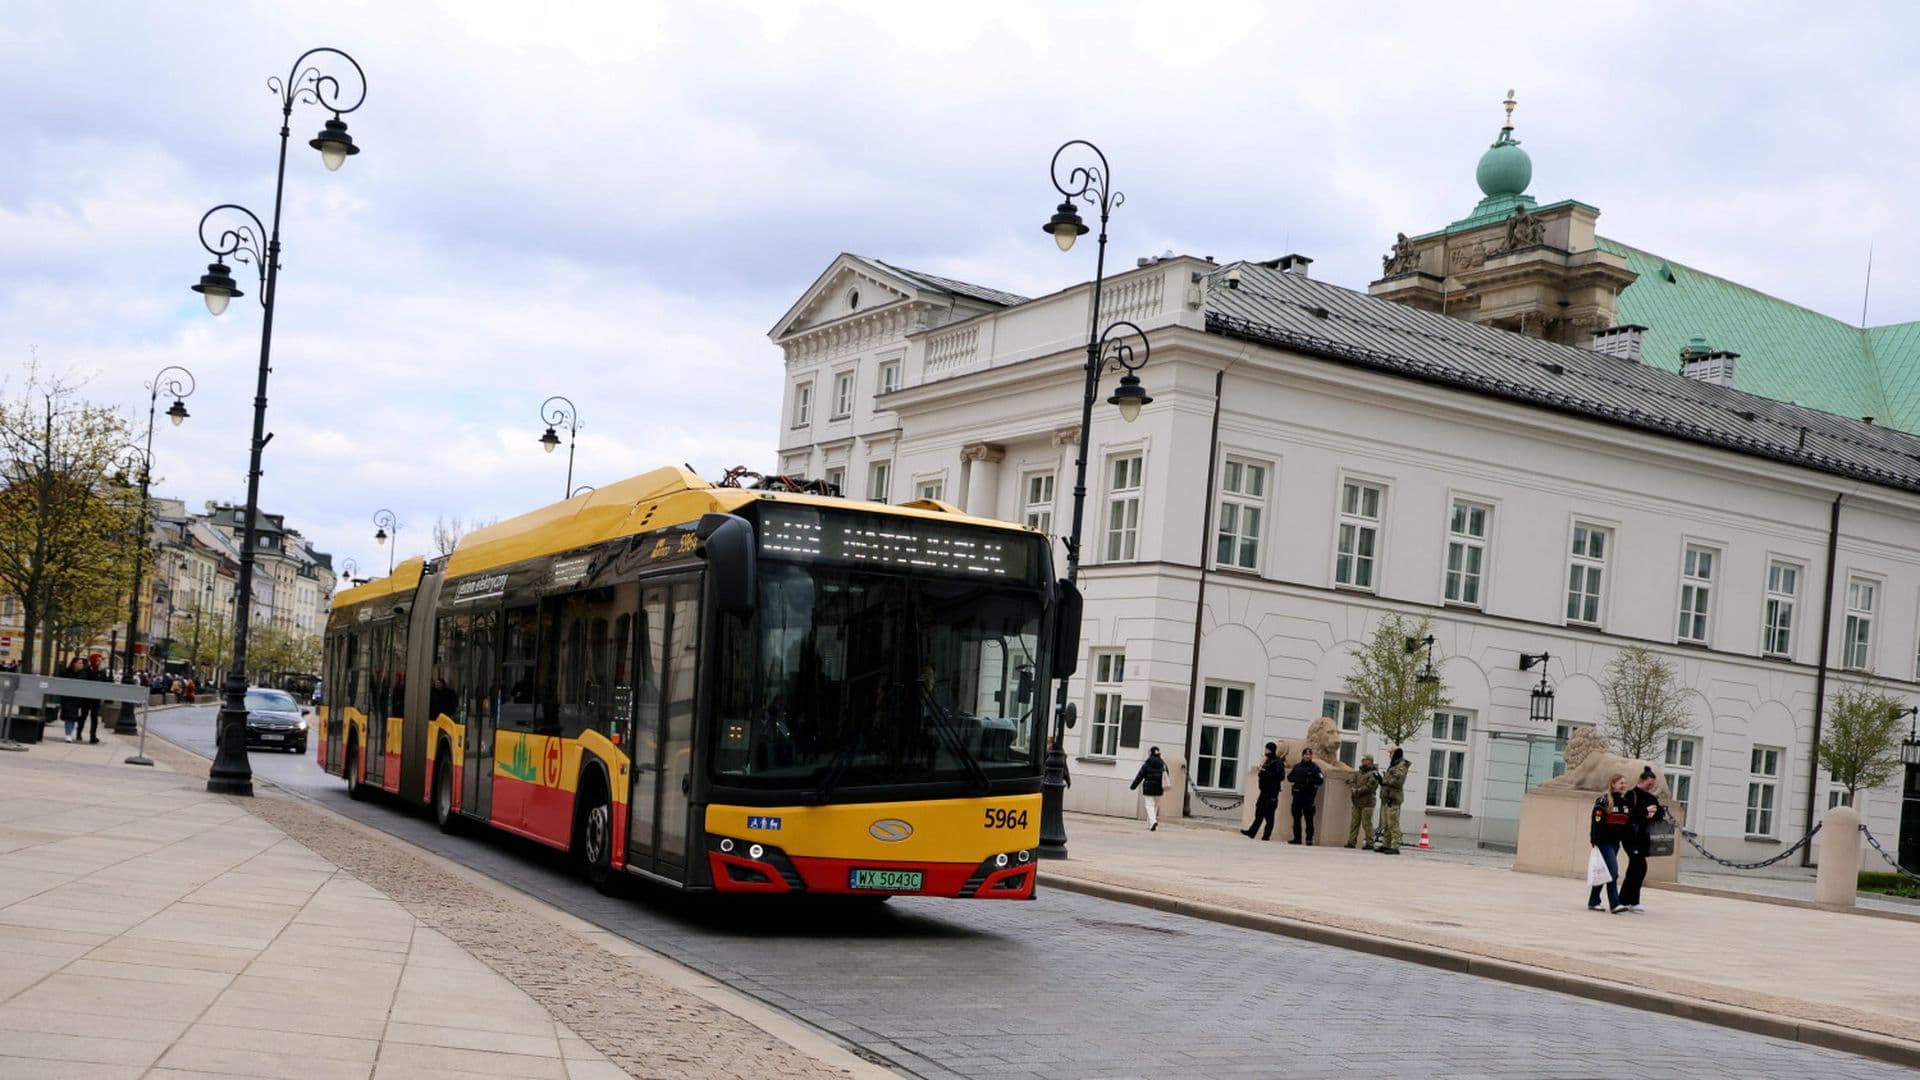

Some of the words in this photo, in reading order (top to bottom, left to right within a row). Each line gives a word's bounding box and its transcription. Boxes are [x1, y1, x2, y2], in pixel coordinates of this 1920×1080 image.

[984, 808, 1028, 830] 5964
[859, 871, 875, 885] WX
[880, 872, 919, 887] 5043C
